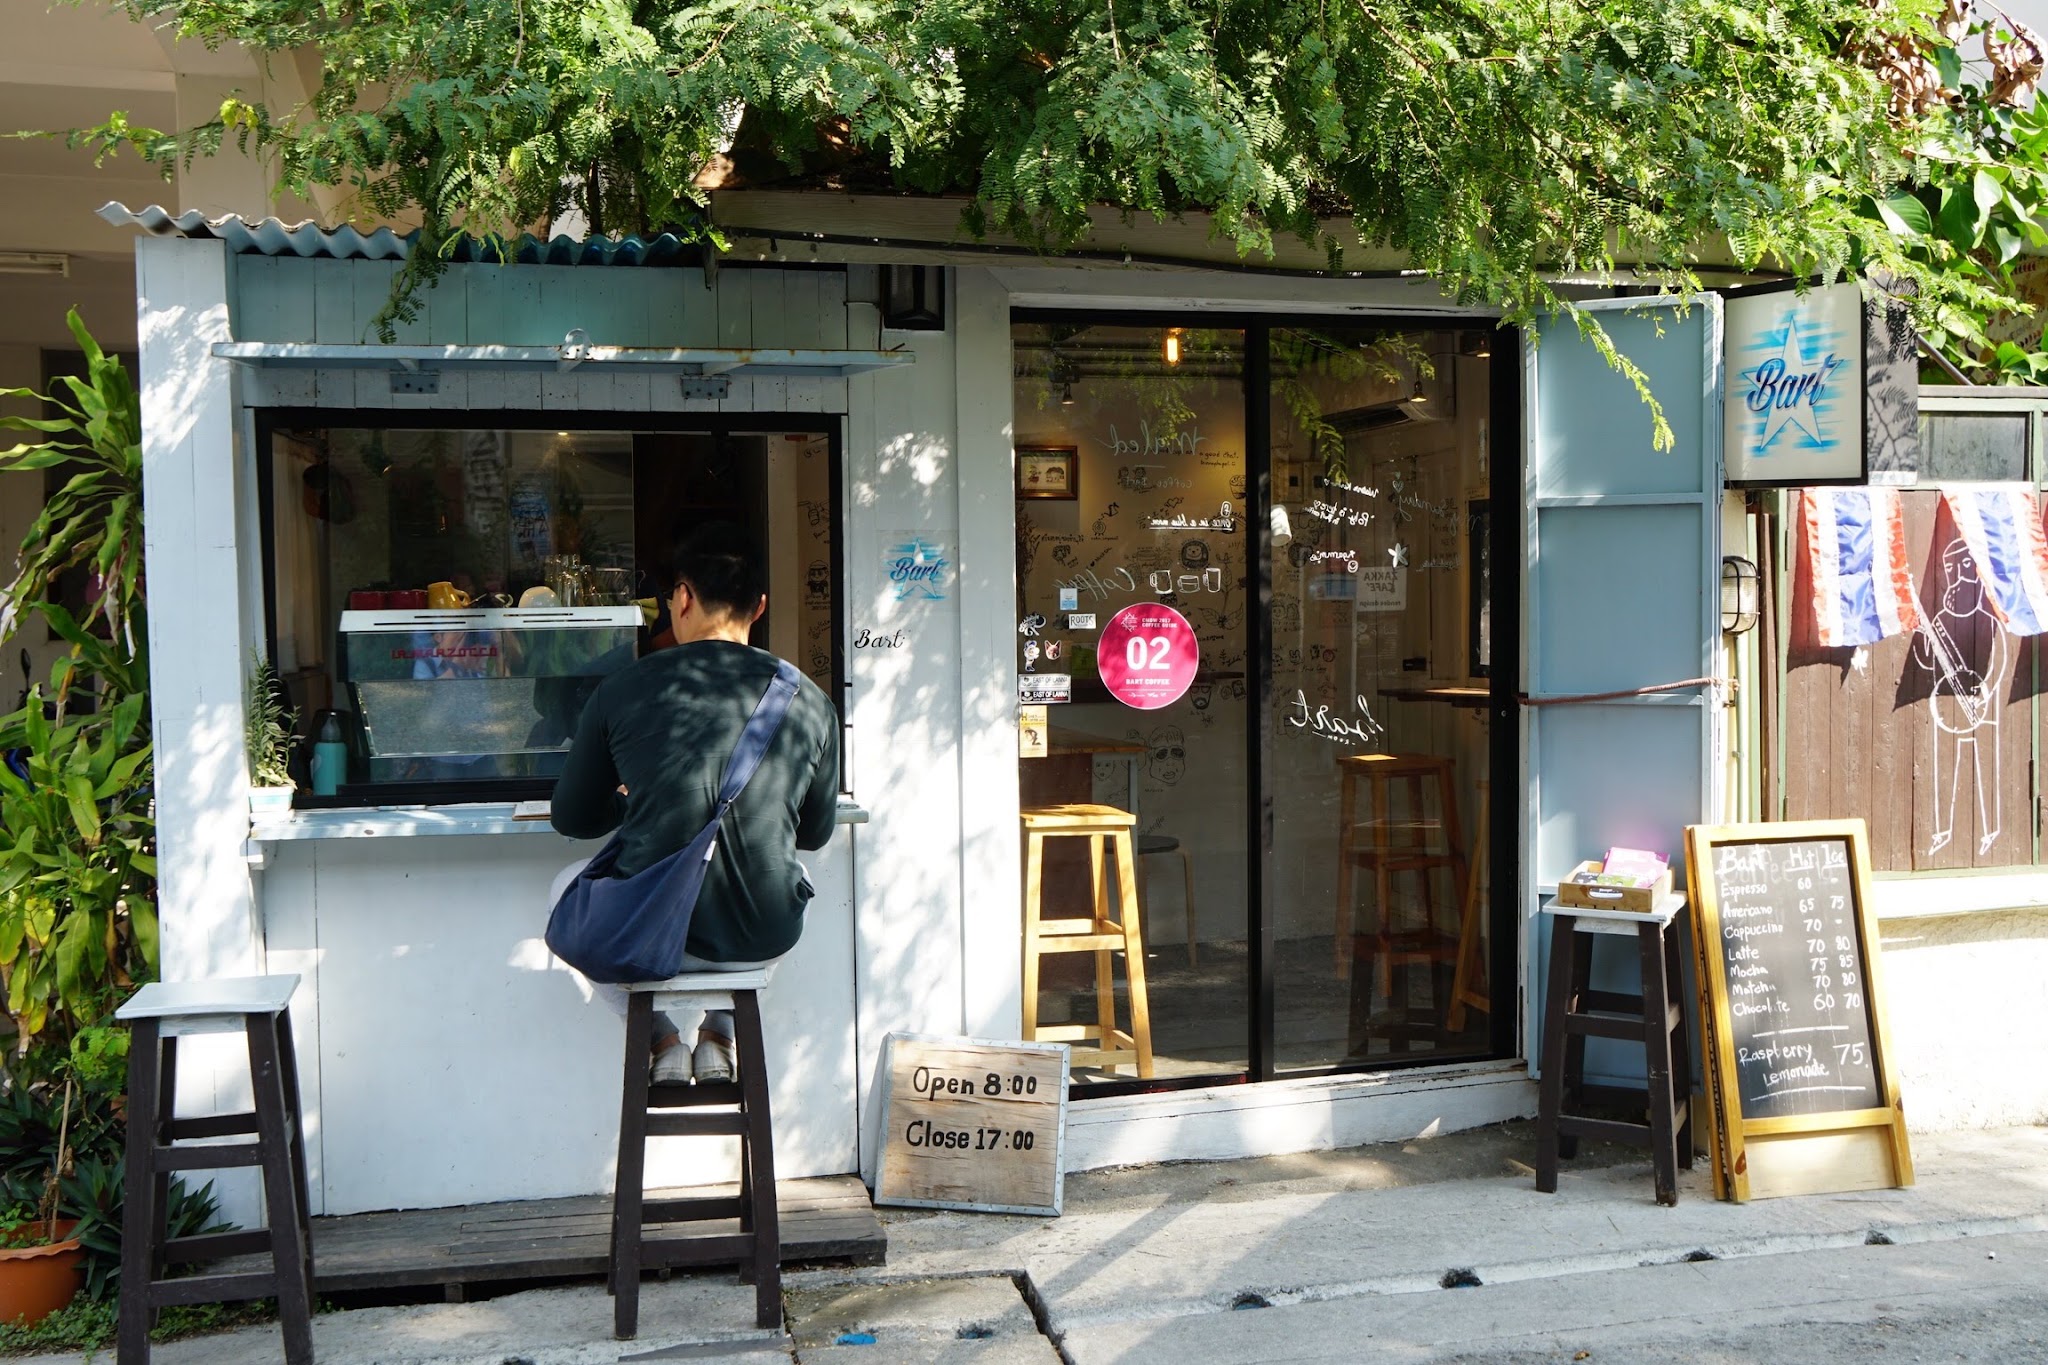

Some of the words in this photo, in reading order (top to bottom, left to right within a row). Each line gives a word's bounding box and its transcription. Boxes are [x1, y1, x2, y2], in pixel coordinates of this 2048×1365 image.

[1746, 353, 1835, 412] Bart
[889, 557, 946, 581] Bart
[1070, 615, 1094, 626] ROOTS
[854, 628, 904, 649] Bart
[1126, 636, 1170, 670] 02
[1032, 676, 1044, 684] EAST
[1715, 844, 1766, 873] Bart
[1721, 882, 1768, 902] Espresso
[1797, 877, 1812, 890] 60
[1723, 901, 1773, 919] Americano
[1799, 898, 1815, 913] 65
[1830, 896, 1844, 910] 75
[1724, 921, 1784, 943] Cappuccino
[1803, 918, 1823, 932] 70
[1728, 945, 1760, 961] Latte
[1806, 938, 1826, 953] 70
[1835, 935, 1851, 951] 80
[1730, 964, 1769, 978] Mocha
[1810, 957, 1828, 972] 75
[1839, 954, 1854, 968] 85
[1813, 975, 1831, 989] 70
[1842, 972, 1856, 986] 80
[1813, 993, 1835, 1011] 60
[1843, 993, 1861, 1009] 70
[913, 1066, 974, 1101] Open
[983, 1073, 1037, 1096] 8:00
[1763, 1058, 1829, 1087] Lemonade
[906, 1120, 970, 1149] Close
[974, 1128, 1034, 1150] 17:00
